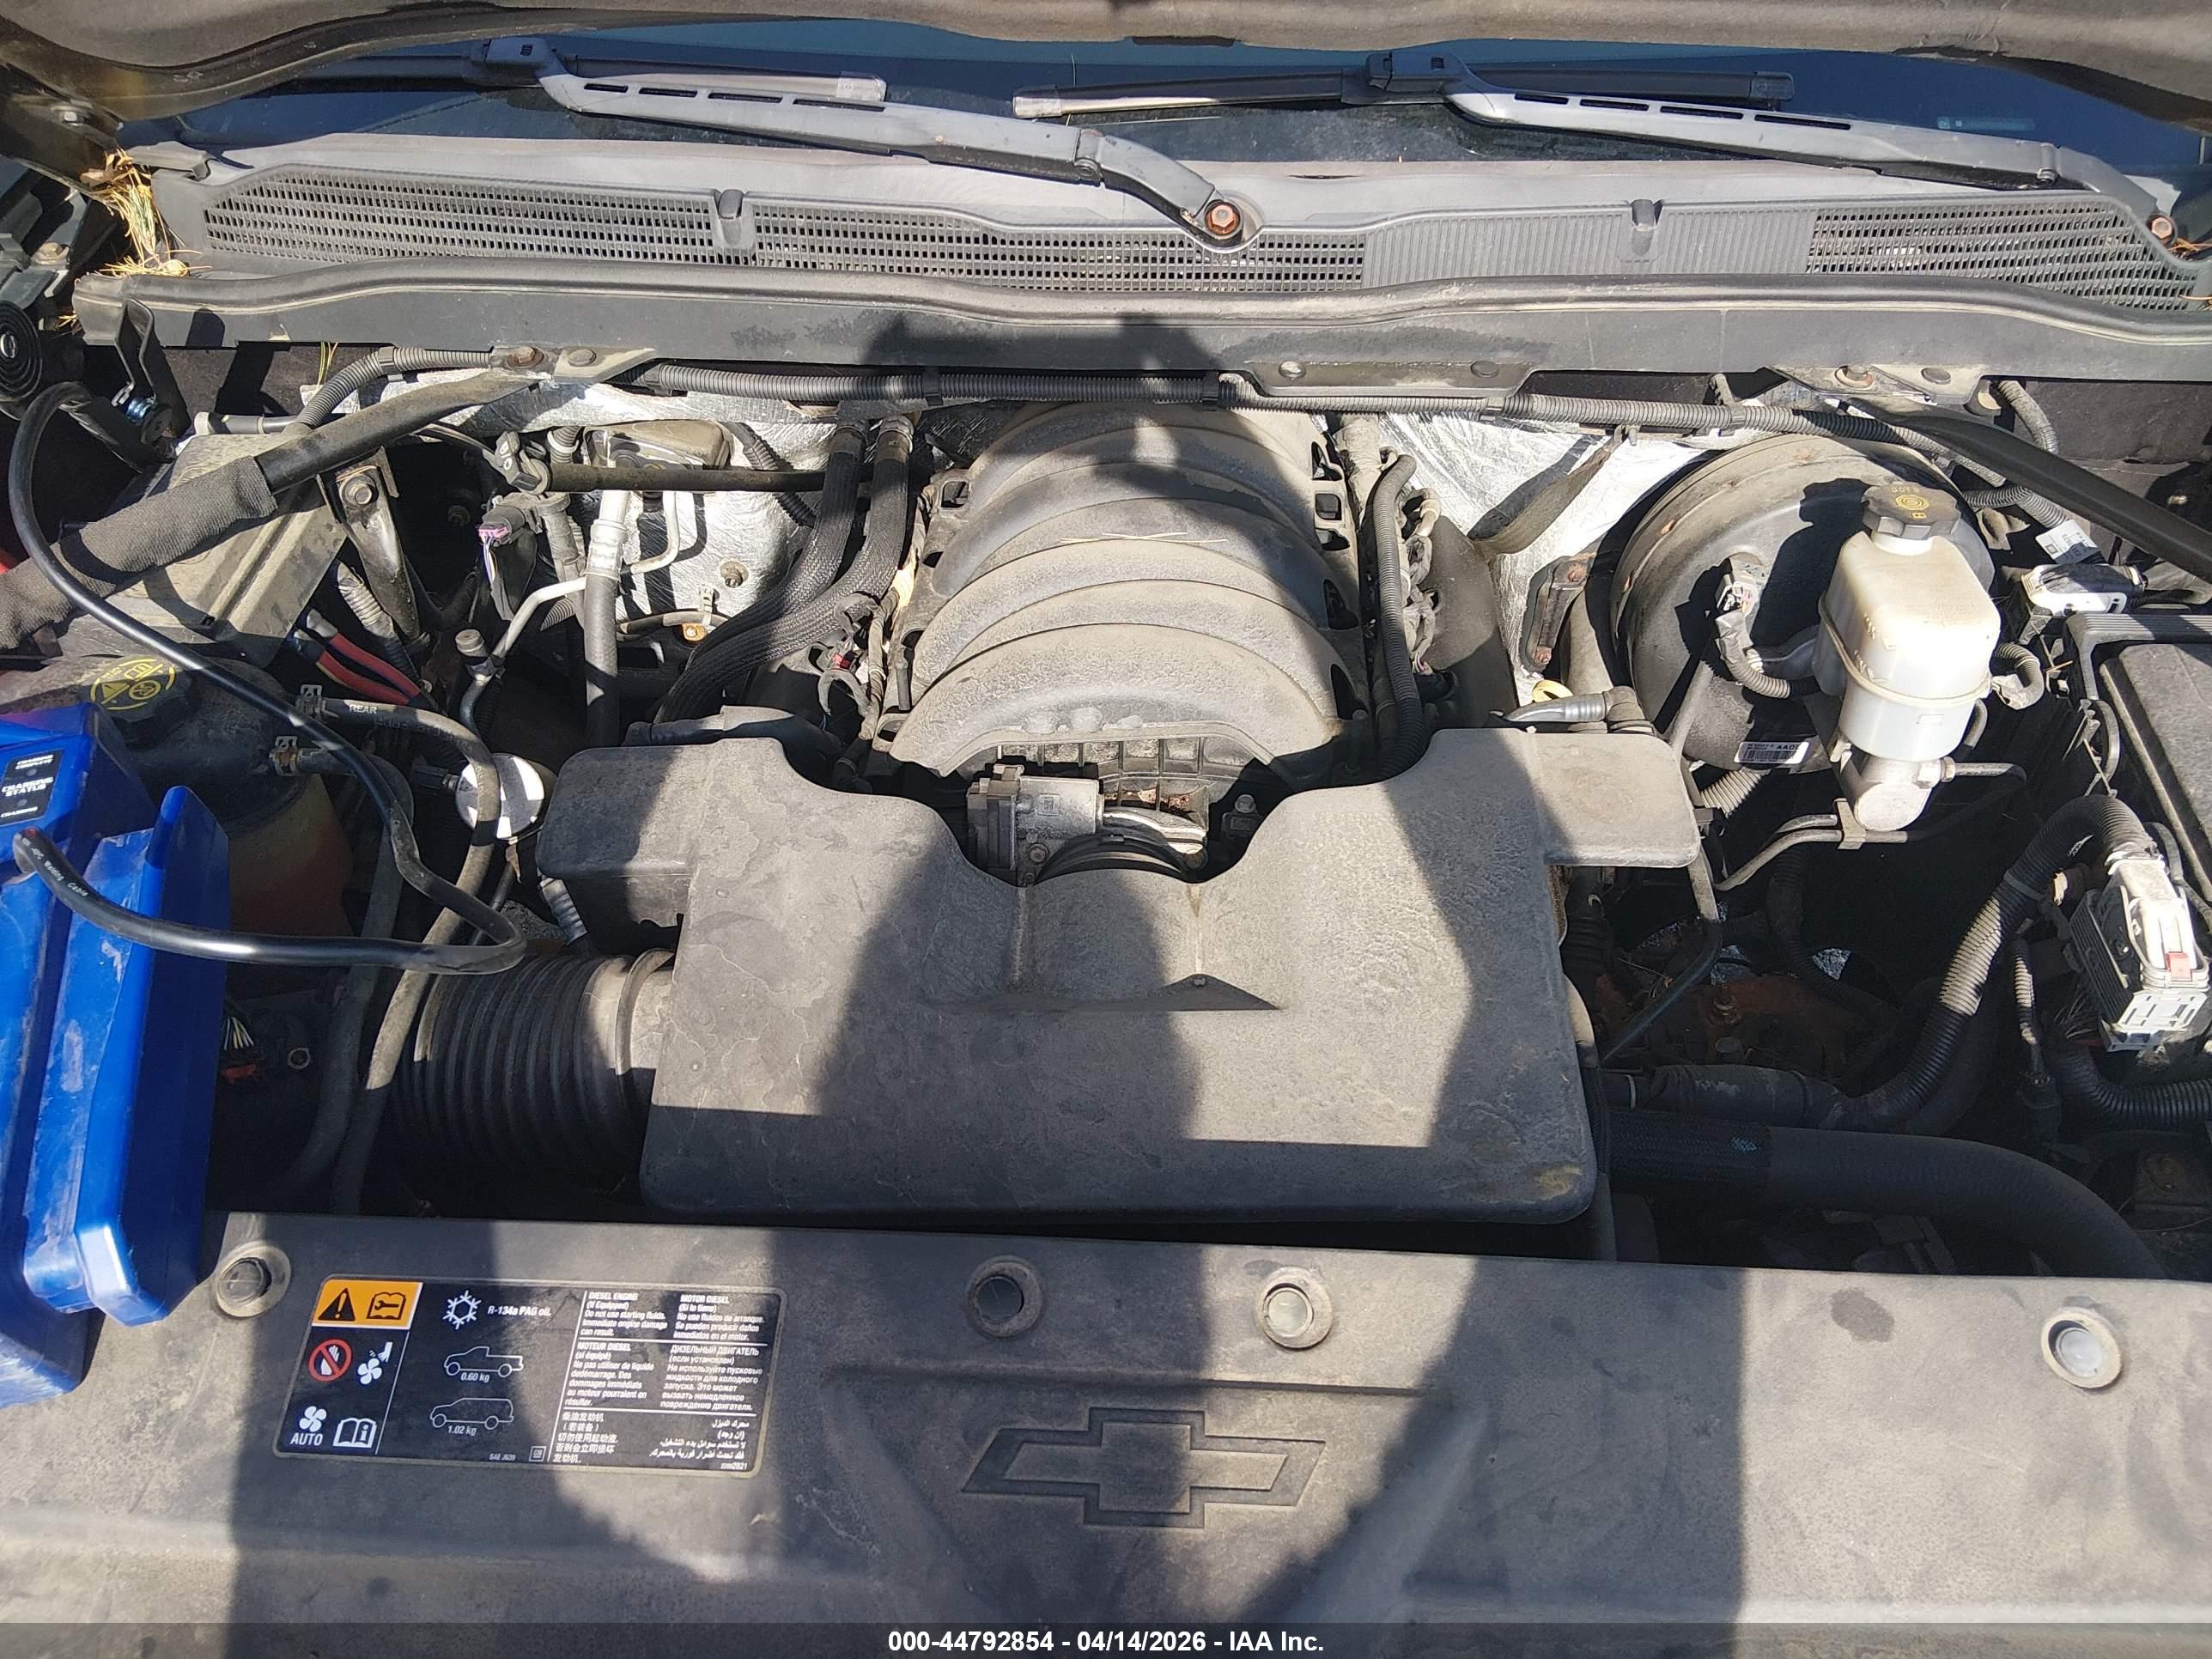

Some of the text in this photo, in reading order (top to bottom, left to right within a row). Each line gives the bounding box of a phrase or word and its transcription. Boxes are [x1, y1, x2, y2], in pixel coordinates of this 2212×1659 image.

[349, 704, 377, 714] REAR
[2, 776, 53, 793] CHARGING
[4, 783, 46, 797] STATUS
[67, 883, 88, 896] Cable
[588, 1291, 639, 1301] DIESEL ENGINE
[680, 1294, 730, 1304] MOTOR DIESEL
[488, 1305, 519, 1316] R-134a
[519, 1306, 538, 1316] PAG
[595, 1302, 629, 1310] Equipped)
[620, 1311, 645, 1320] starting
[646, 1311, 665, 1320] fluids.
[677, 1312, 687, 1321] No
[701, 1313, 723, 1322] fluidos
[582, 1319, 668, 1330] Immediate engine damage
[685, 1322, 710, 1331] pueden
[739, 1323, 760, 1332] daños
[577, 1341, 607, 1351] MOTEUR
[670, 1344, 760, 1356] ДИЗЕЛЬНЫЙ ДВИГАТЕЛЬ
[669, 1354, 690, 1363] (если
[632, 1363, 655, 1371] liquide
[678, 1364, 726, 1374] используйте
[460, 1372, 490, 1382] 0.60 kg
[665, 1373, 703, 1382] жидкости
[568, 1379, 642, 1389] dommages immédiats
[697, 1382, 712, 1391] Это
[602, 1389, 638, 1399] pourraient
[660, 1401, 712, 1409] повреждение
[562, 1411, 604, 1422] 柴油发动机
[447, 1425, 477, 1436] 1.02 kg
[289, 1432, 323, 1446] AUTO
